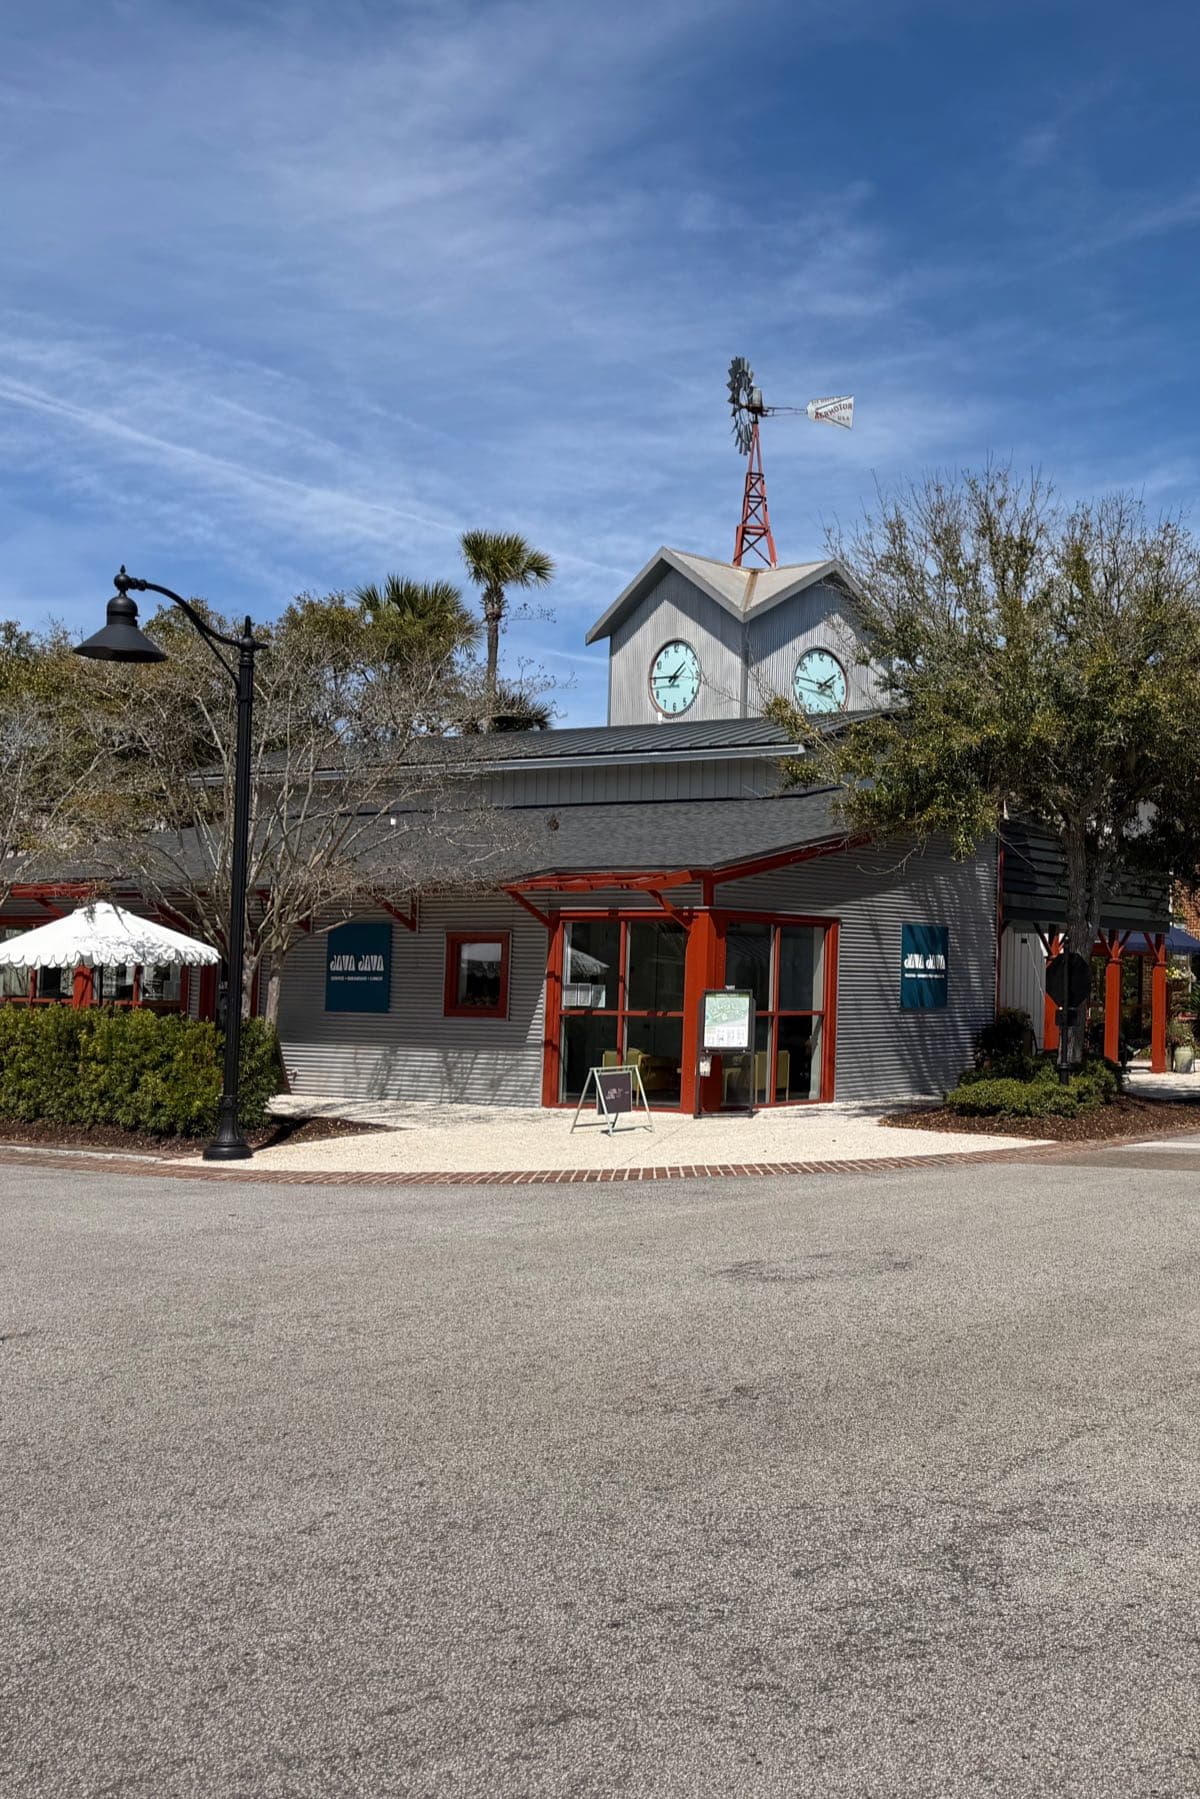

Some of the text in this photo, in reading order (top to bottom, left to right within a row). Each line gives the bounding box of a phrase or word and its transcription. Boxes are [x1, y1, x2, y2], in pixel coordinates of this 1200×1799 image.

[330, 954, 384, 971] JAVA JAVA
[904, 953, 946, 970] JAVA JAVA
